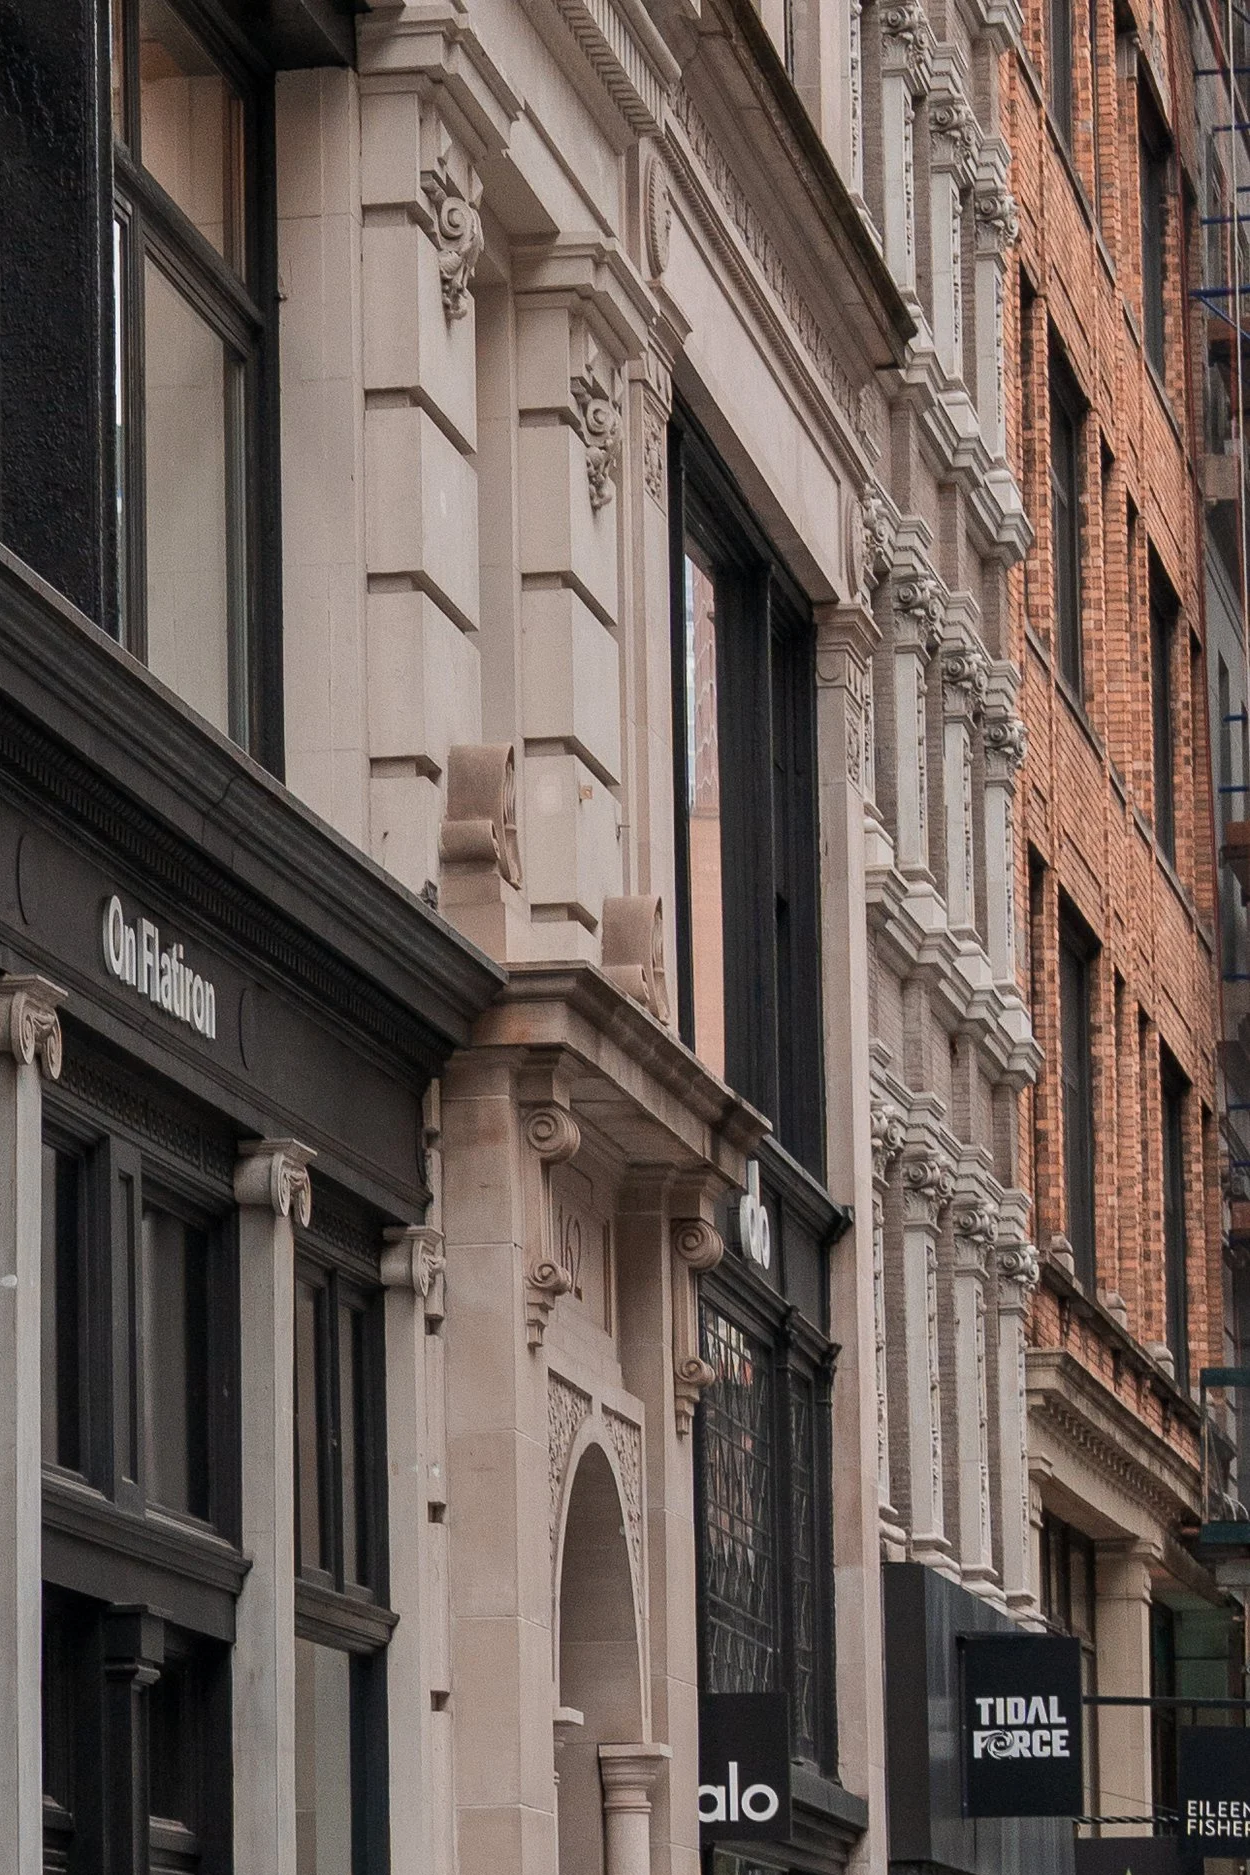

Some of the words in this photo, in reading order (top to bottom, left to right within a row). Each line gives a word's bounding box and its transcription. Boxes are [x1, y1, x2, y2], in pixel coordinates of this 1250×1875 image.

[103, 895, 137, 986] On
[137, 917, 216, 1040] Flatiron
[975, 1696, 1067, 1726] TIDAL
[973, 1729, 1070, 1760] FORCE
[699, 1761, 779, 1823] alo
